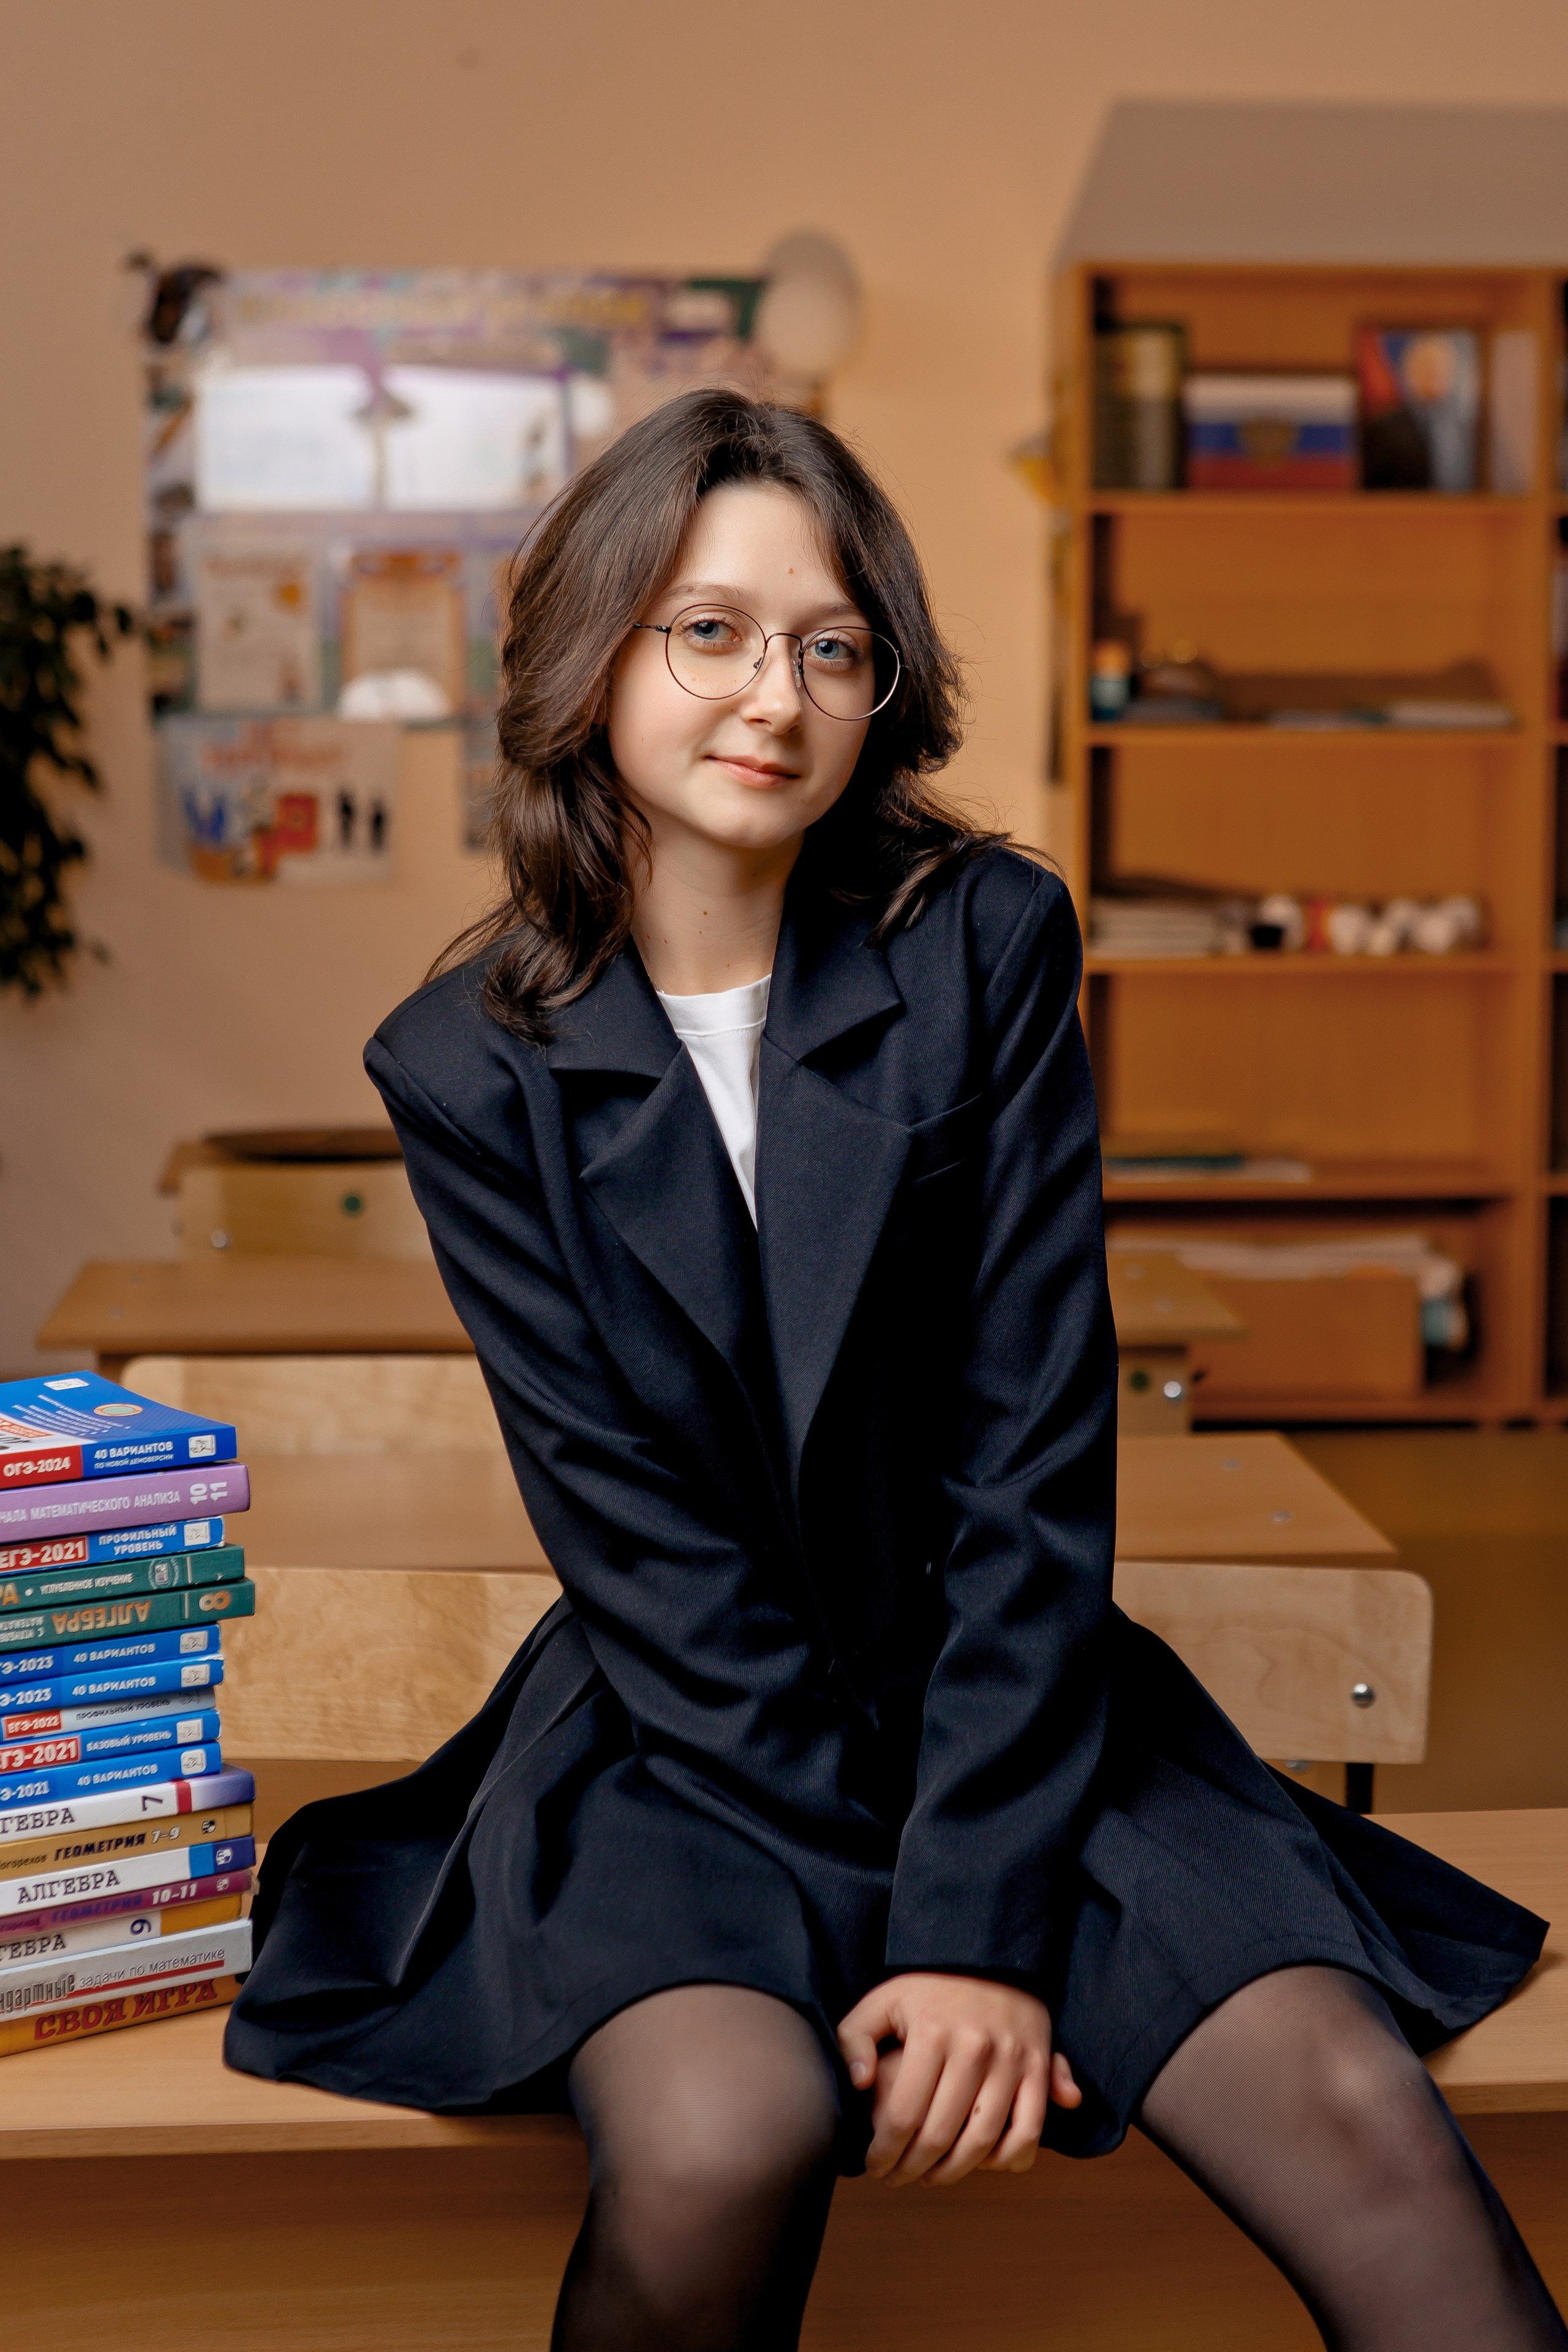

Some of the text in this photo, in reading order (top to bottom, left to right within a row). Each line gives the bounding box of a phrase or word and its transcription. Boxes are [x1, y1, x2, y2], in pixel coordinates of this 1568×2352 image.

[94, 1441, 174, 1460] 40 ВАРИАНТОВ
[105, 1458, 130, 1468] НОВОЙ
[129, 1453, 174, 1465] ДЕМОВЕРСИИ
[4, 1457, 72, 1477] ОГЭ-2024
[190, 1482, 207, 1506] 10
[210, 1481, 228, 1502] 11
[30, 1496, 130, 1520] МАТЕМАТИЧЕСКОГО
[134, 1491, 181, 1509] АНАЛИЗА
[98, 1524, 177, 1546] ПРОФИЛЬНЫЙ
[0, 1541, 86, 1568] ЕГЭ-2021
[113, 1541, 164, 1556] УРОВЕНЬ
[199, 1591, 230, 1611] 8
[51, 1600, 151, 1635] АЛГЕБРА
[74, 1643, 156, 1663] 40 ВАРИАНТОВ
[0, 1655, 54, 1675] Э-2023
[72, 1676, 157, 1696] 40 ВАРИАНТОВ
[76, 1698, 172, 1721] ПРОФИЛЬНЫЙ УРОВЕНЬ
[7, 1714, 59, 1733] ЕГЭ-2022
[86, 1729, 172, 1752] БАЗОВЫЙ УРОВЕНЬ
[77, 1763, 159, 1787] 40 ВАРИАНТОВ
[141, 1795, 164, 1812] 7
[0, 1807, 75, 1833] ГЕБРА
[54, 1832, 147, 1862] ГЕОМЕТРИЯ
[151, 1825, 181, 1844] 7-9
[17, 1869, 121, 1905] АЛГЕБРА
[152, 1882, 197, 1905] 10-11
[79, 1969, 125, 1988] задачи
[129, 1962, 146, 1978] по
[148, 1948, 226, 1973] математике
[34, 1978, 218, 2040] СВОЯ ИГРА
